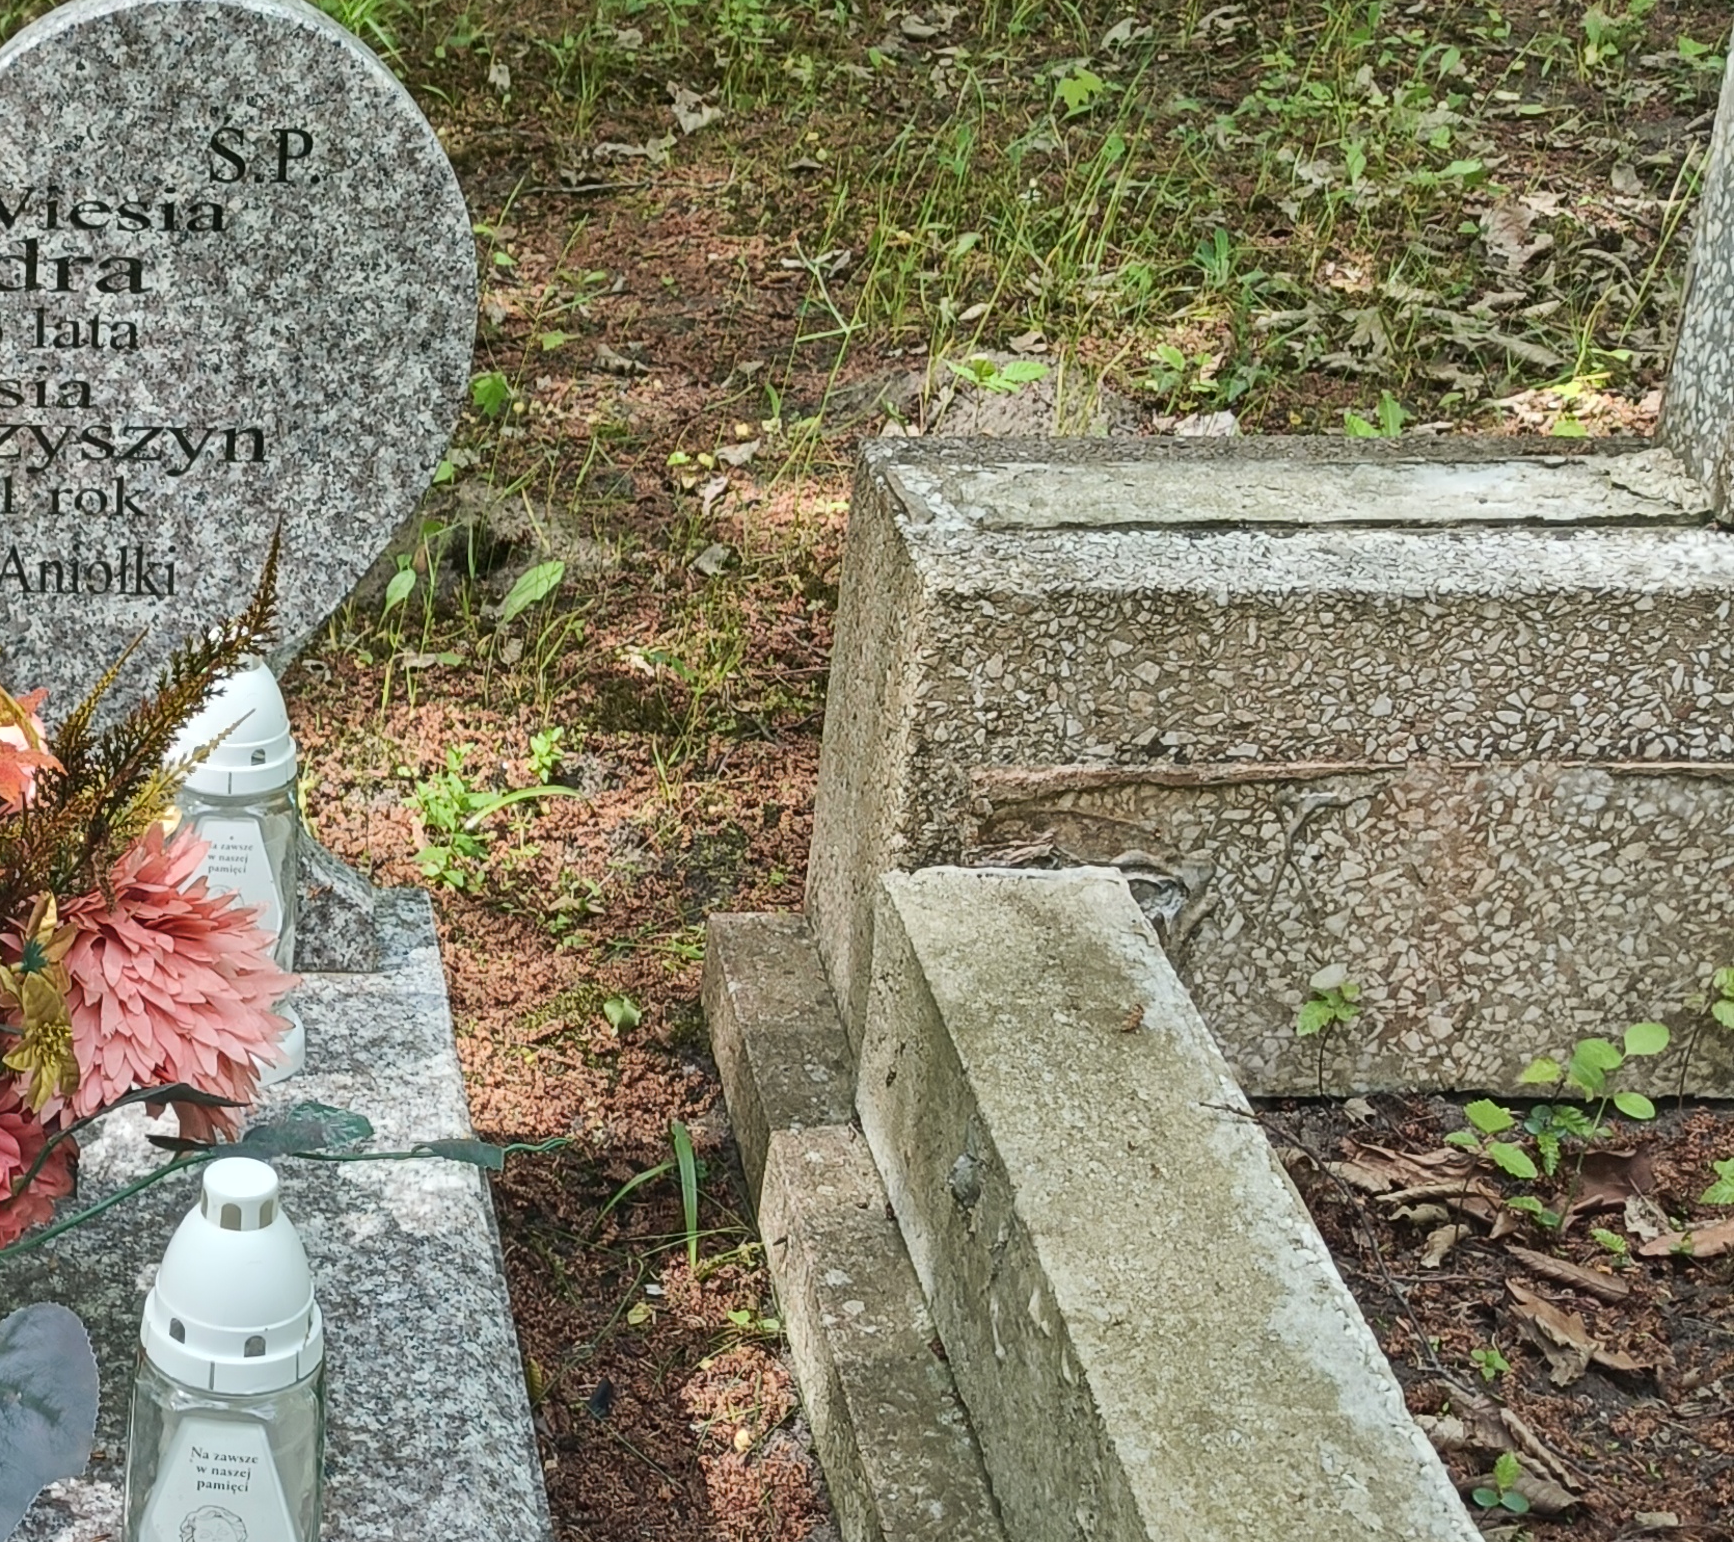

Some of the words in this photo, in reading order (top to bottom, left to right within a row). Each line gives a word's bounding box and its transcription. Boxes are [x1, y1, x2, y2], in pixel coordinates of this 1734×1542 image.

[32, 306, 140, 351] lata
[0, 476, 19, 515] 1
[50, 475, 148, 517] rok
[221, 843, 254, 851] zawsze
[219, 853, 248, 864] naszej
[208, 864, 247, 876] pamięci
[191, 1446, 209, 1459] Na
[214, 1452, 259, 1464] zawsze
[196, 1465, 207, 1473] w
[211, 1467, 251, 1480] naszej
[196, 1480, 248, 1495] pamięci
